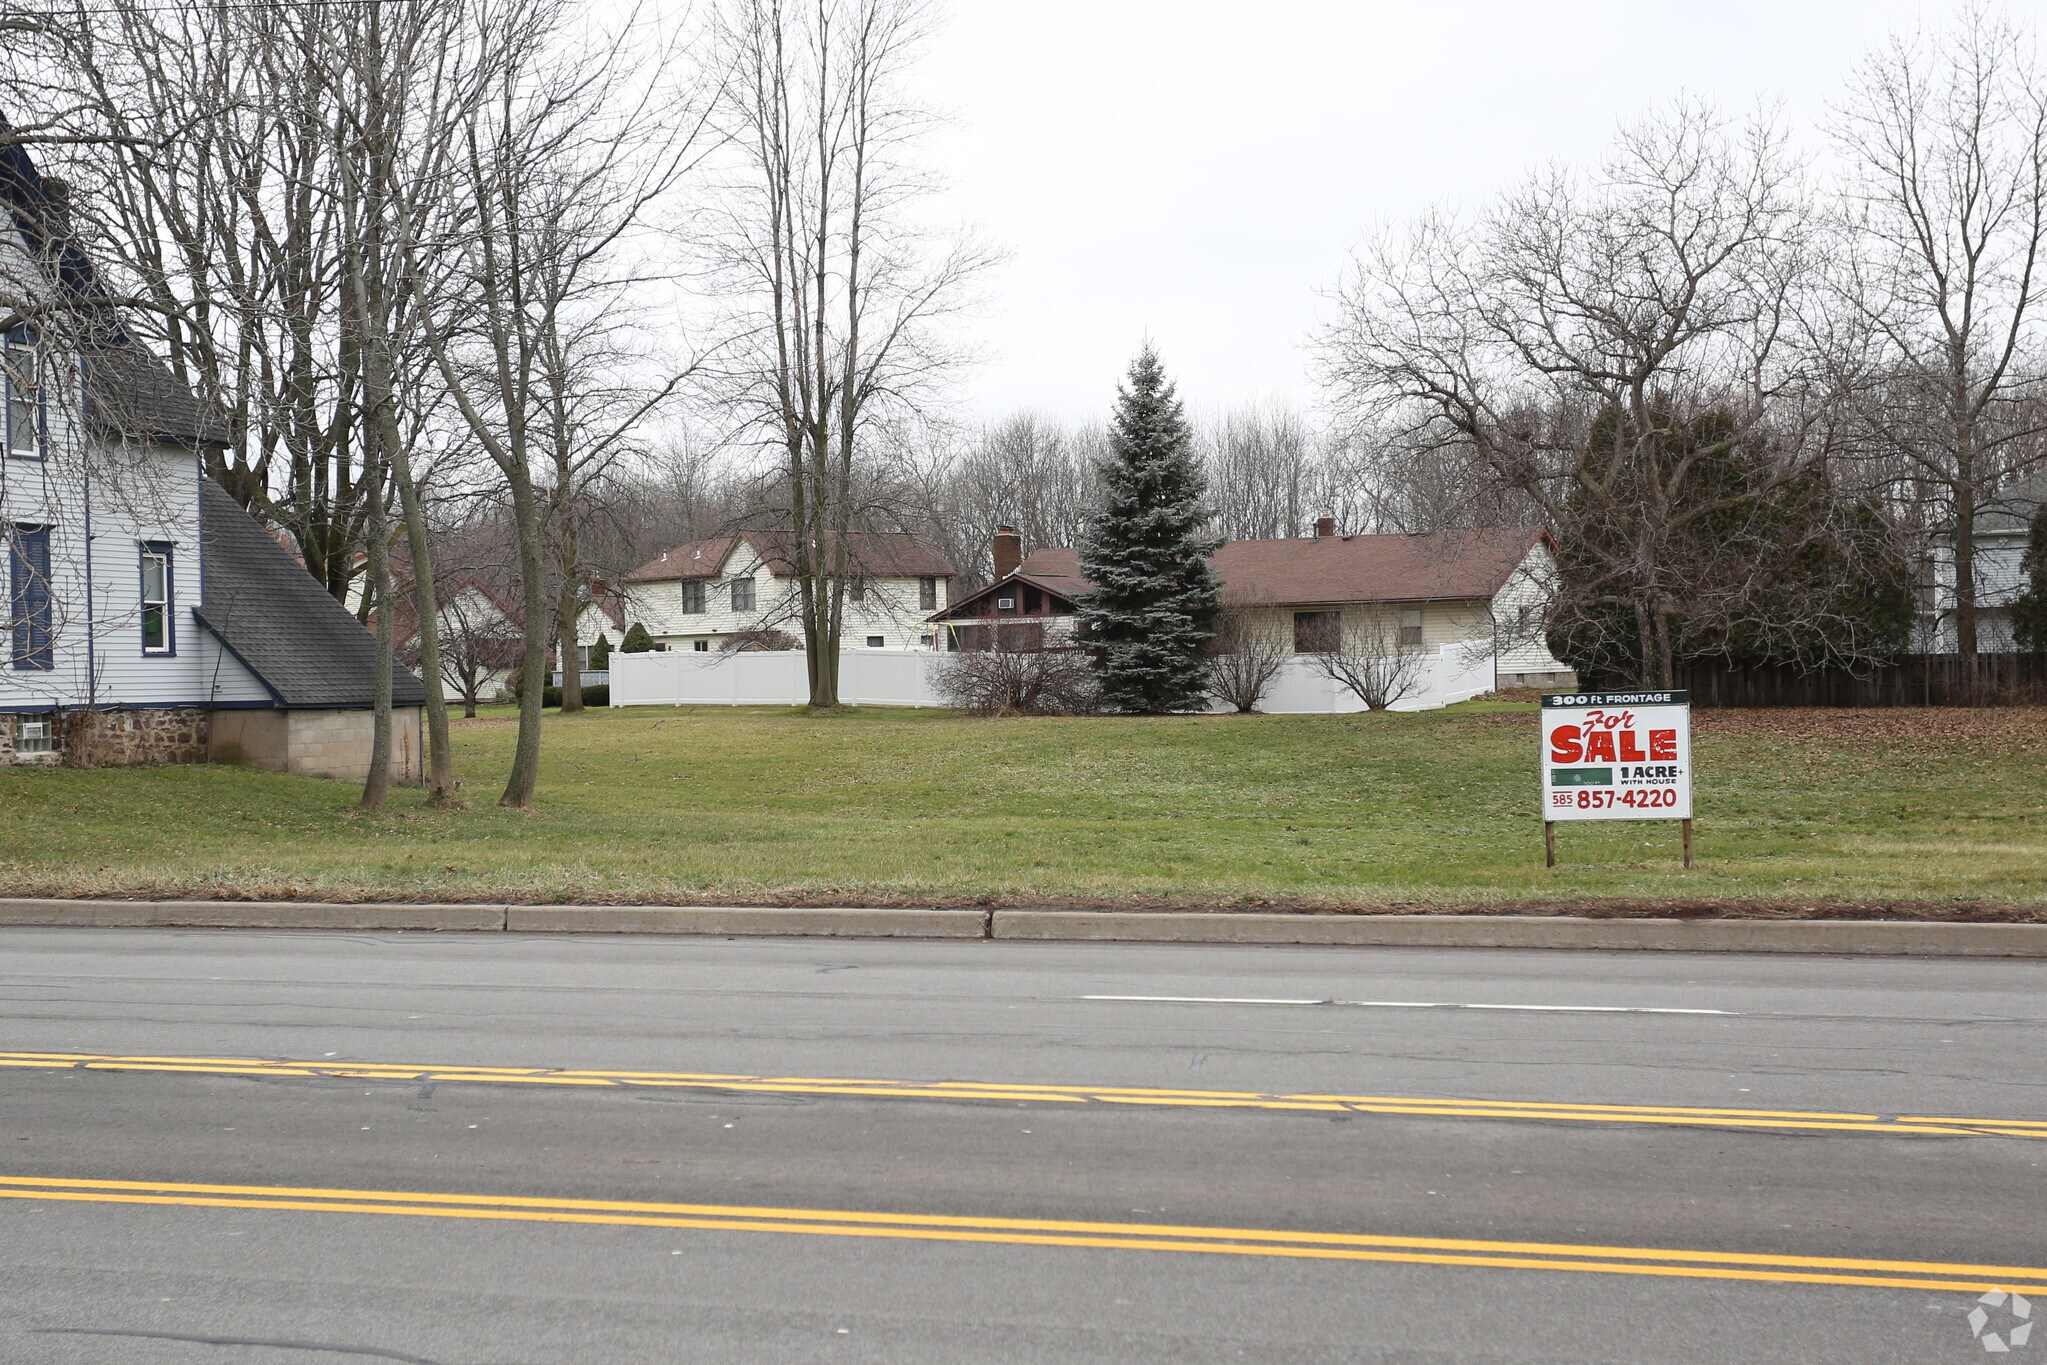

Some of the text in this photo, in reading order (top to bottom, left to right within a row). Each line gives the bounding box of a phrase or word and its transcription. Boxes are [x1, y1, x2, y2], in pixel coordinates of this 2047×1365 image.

[1552, 693, 1671, 706] 300 ft FRONTAGE
[1583, 711, 1636, 738] For
[1551, 725, 1677, 763] SALE
[1552, 788, 1677, 809] 585 857-4220
